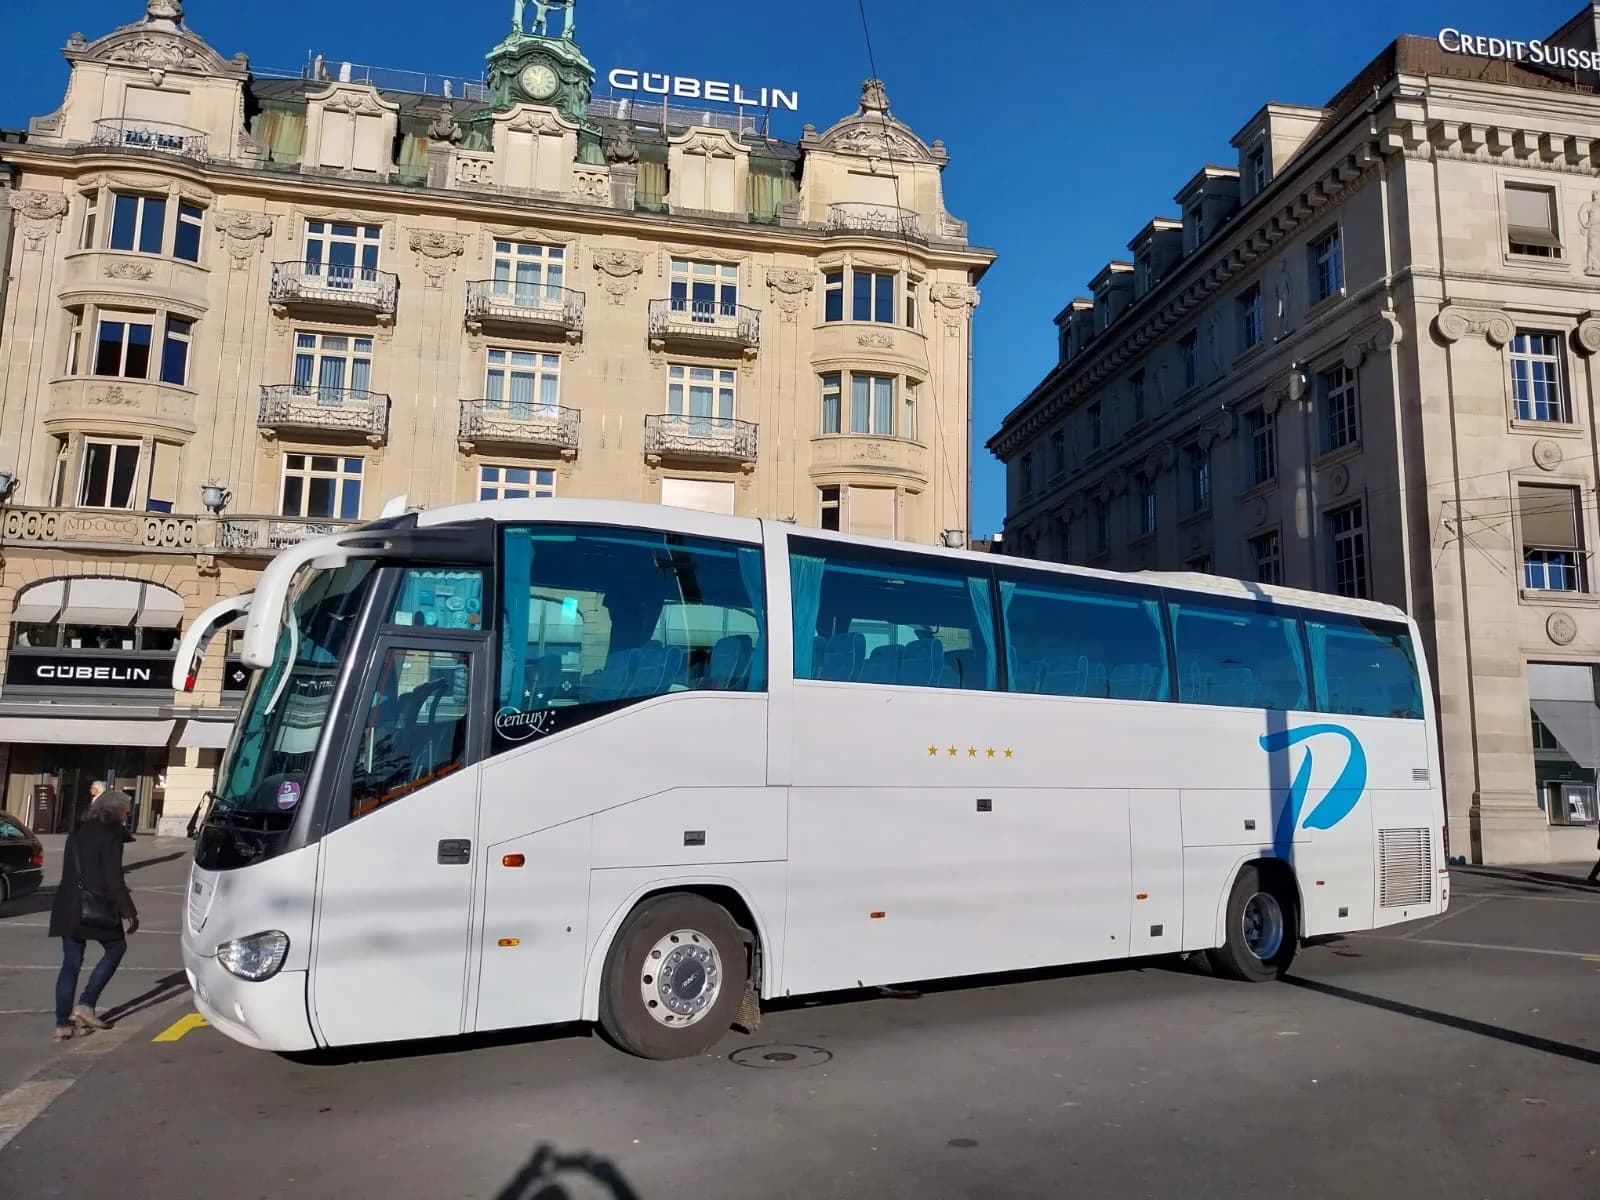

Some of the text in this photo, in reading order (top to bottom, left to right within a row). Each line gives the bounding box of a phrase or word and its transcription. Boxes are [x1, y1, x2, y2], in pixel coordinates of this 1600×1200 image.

[1438, 27, 1600, 71] CREDIT SUISSE
[608, 68, 799, 111] GÜBELIN
[36, 665, 151, 681] GÜBELIN
[496, 710, 548, 733] Century
